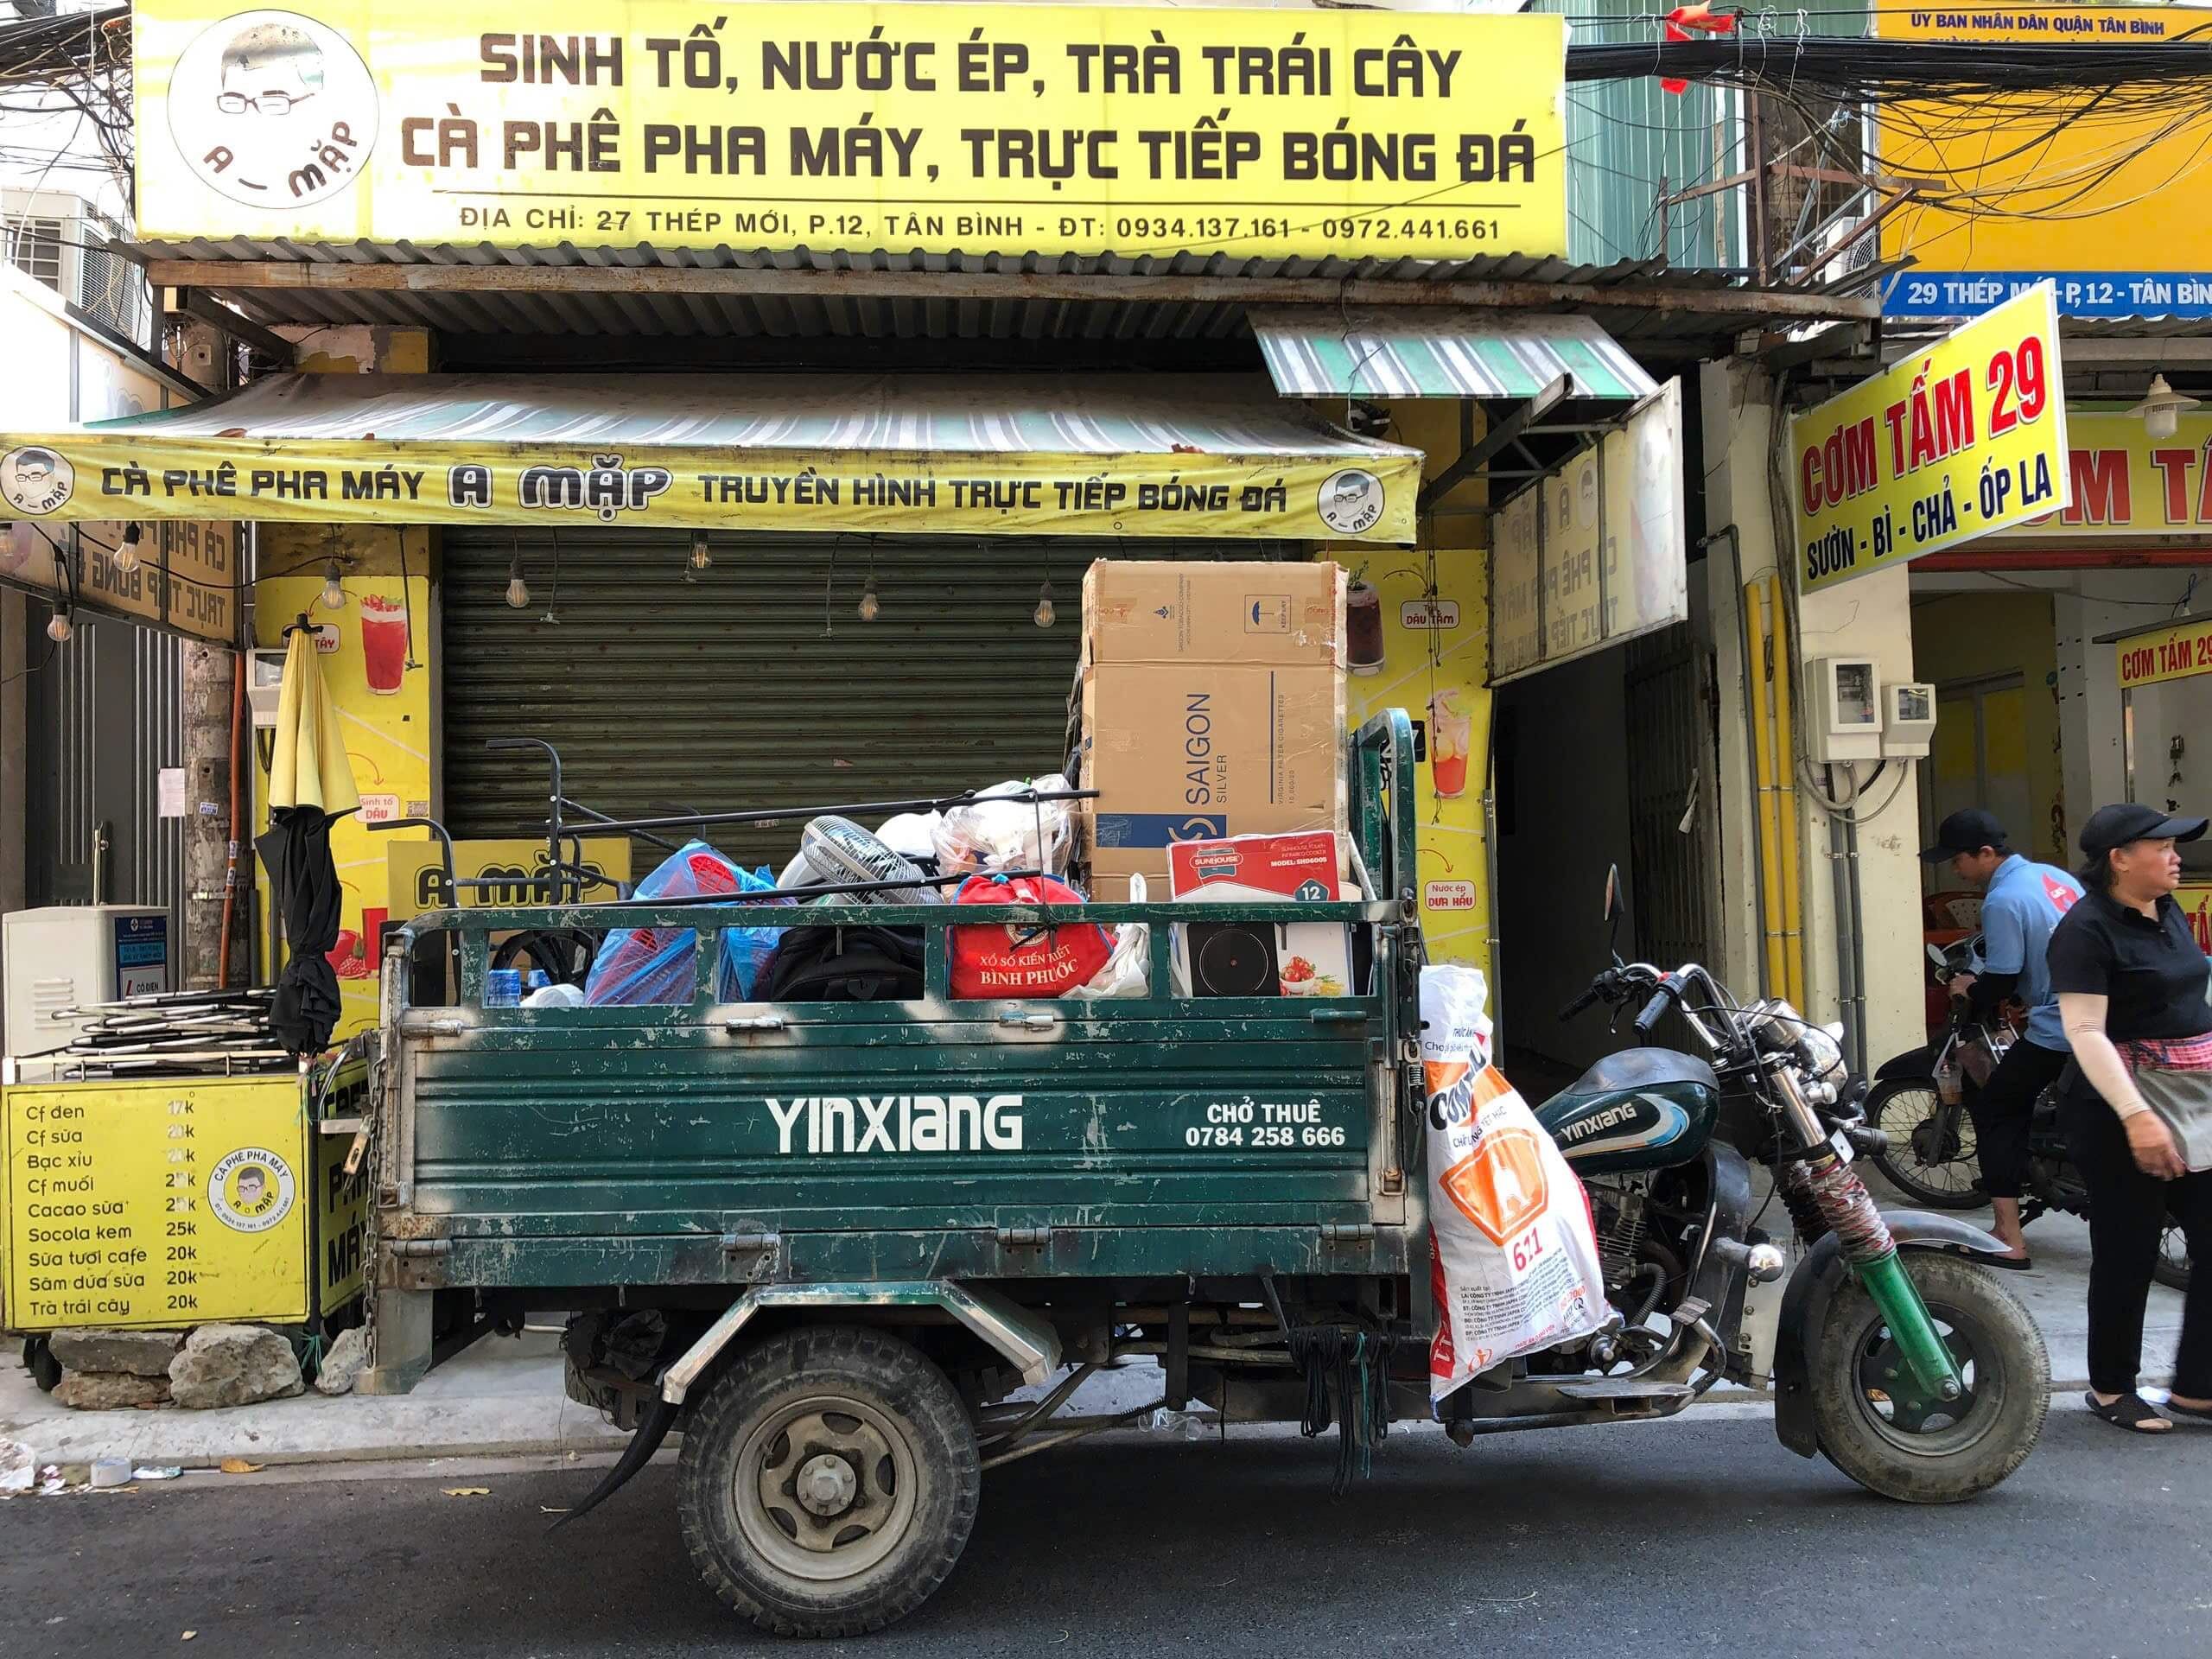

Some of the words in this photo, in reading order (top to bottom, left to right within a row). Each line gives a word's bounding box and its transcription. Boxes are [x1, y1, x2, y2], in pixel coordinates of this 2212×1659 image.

[1936, 14, 1967, 28] BAN
[1972, 13, 2013, 29] NHÂN
[2018, 13, 2048, 30] DÂN
[2053, 15, 2093, 34] QUẬN
[2098, 16, 2126, 34] TÂN
[2130, 17, 2164, 35] BÌNH
[480, 32, 623, 87] SINH
[646, 16, 739, 95] TỐ,
[763, 25, 937, 92] NƯỚC
[957, 27, 1046, 99] ÉP,
[1067, 29, 1181, 95] TRÀ
[1201, 31, 1332, 97] TRÁI
[1353, 33, 1462, 98] CÂY
[402, 103, 477, 170] CÀ
[505, 107, 620, 174] PHÊ
[645, 124, 766, 175] PHA
[791, 112, 940, 182] MÁY,
[960, 128, 1120, 191] TRỰC
[1138, 108, 1261, 180] TIẾP
[1283, 116, 1436, 181] BÓNG
[1456, 118, 1535, 184] ĐÁ
[202, 146, 234, 173] A
[288, 121, 360, 198] MẶP
[460, 207, 511, 232] ĐỊA
[525, 205, 584, 231] CHỈ:
[597, 210, 632, 232] 27
[645, 207, 722, 233] THÉP
[734, 207, 798, 236] MỚI,
[884, 212, 944, 236] TÂN
[957, 211, 1024, 237] BÌNH
[1058, 217, 1106, 237] ĐT:
[1116, 217, 1291, 238] 0934.137.161
[1322, 219, 1502, 241] 0972.441.661
[1908, 283, 1938, 305] 29
[1944, 277, 2005, 305] THÉP
[2086, 283, 2113, 304] 12
[2129, 277, 2171, 304] TÂN
[2177, 277, 2212, 305] BÌN
[1802, 415, 1878, 517] CƠM
[1885, 359, 1976, 480] TẤM
[1986, 335, 2046, 440] 29
[14, 493, 23, 504] A
[41, 481, 67, 510] MẶP
[102, 459, 153, 496] CÀ
[163, 461, 238, 497] PHÊ
[251, 469, 328, 499] PHA
[341, 462, 428, 501] MÁY
[447, 463, 493, 510] A
[518, 453, 674, 522] MẶP
[697, 467, 840, 507] TRUYỀN
[853, 469, 936, 507] HÌNH
[948, 480, 1041, 515] TRỰC
[1053, 471, 1128, 511] TIẾP
[1138, 474, 1230, 512] BÓNG
[1240, 477, 1287, 513] ĐÁ
[1327, 512, 1338, 522] A
[1353, 504, 1377, 530] MẶP
[1807, 522, 1855, 581] SƯỜN
[1872, 505, 1893, 558] BÌ
[1912, 474, 1957, 543] CHẢ
[1979, 456, 2012, 520] ỐP
[2019, 452, 2053, 507] LA
[2122, 648, 2155, 681] CƠM
[2158, 632, 2192, 673] TẤM
[2197, 635, 2212, 666] 29
[1185, 693, 1211, 805] SAIGON
[1216, 753, 1228, 804] SILVER
[384, 796, 393, 805] tố
[365, 807, 388, 819] DÂU
[1195, 855, 1239, 865] SUNHOUSE
[415, 863, 454, 908] A
[1301, 886, 1321, 900] 12
[1432, 884, 1453, 893] Nước
[1428, 896, 1449, 906] DƯA
[1452, 892, 1473, 906] HẤU
[980, 969, 1023, 985] BÌNH
[1424, 1041, 1445, 1052] Cho
[26, 1106, 46, 1123] Cf
[1206, 1096, 1255, 1124] CHỞ
[1261, 1098, 1322, 1123] THUÊ
[26, 1129, 47, 1147] Cf
[51, 1128, 83, 1143] sữa
[1185, 1127, 1243, 1147] 0784
[1251, 1127, 1294, 1147] 258
[1301, 1127, 1345, 1147] 666
[28, 1154, 62, 1172] Bạc
[67, 1150, 92, 1167] xỉu
[247, 1151, 267, 1163] PHA
[28, 1179, 48, 1197] Cf
[53, 1175, 94, 1192] muối
[29, 1204, 86, 1217] Cacao
[92, 1201, 124, 1216] sữa
[29, 1226, 91, 1243] Socola
[96, 1225, 132, 1240] kem
[166, 1221, 197, 1236] 25k
[29, 1252, 63, 1267] Sữa
[69, 1249, 102, 1265] tươi
[107, 1247, 147, 1266] cafe
[166, 1246, 197, 1261] 20k
[29, 1276, 67, 1292] Sâm
[113, 1273, 145, 1287] sữa
[166, 1270, 198, 1286] 20k
[29, 1300, 57, 1316] Trà
[63, 1299, 91, 1314] trái
[97, 1299, 130, 1316] cây
[167, 1294, 199, 1310] 20k
